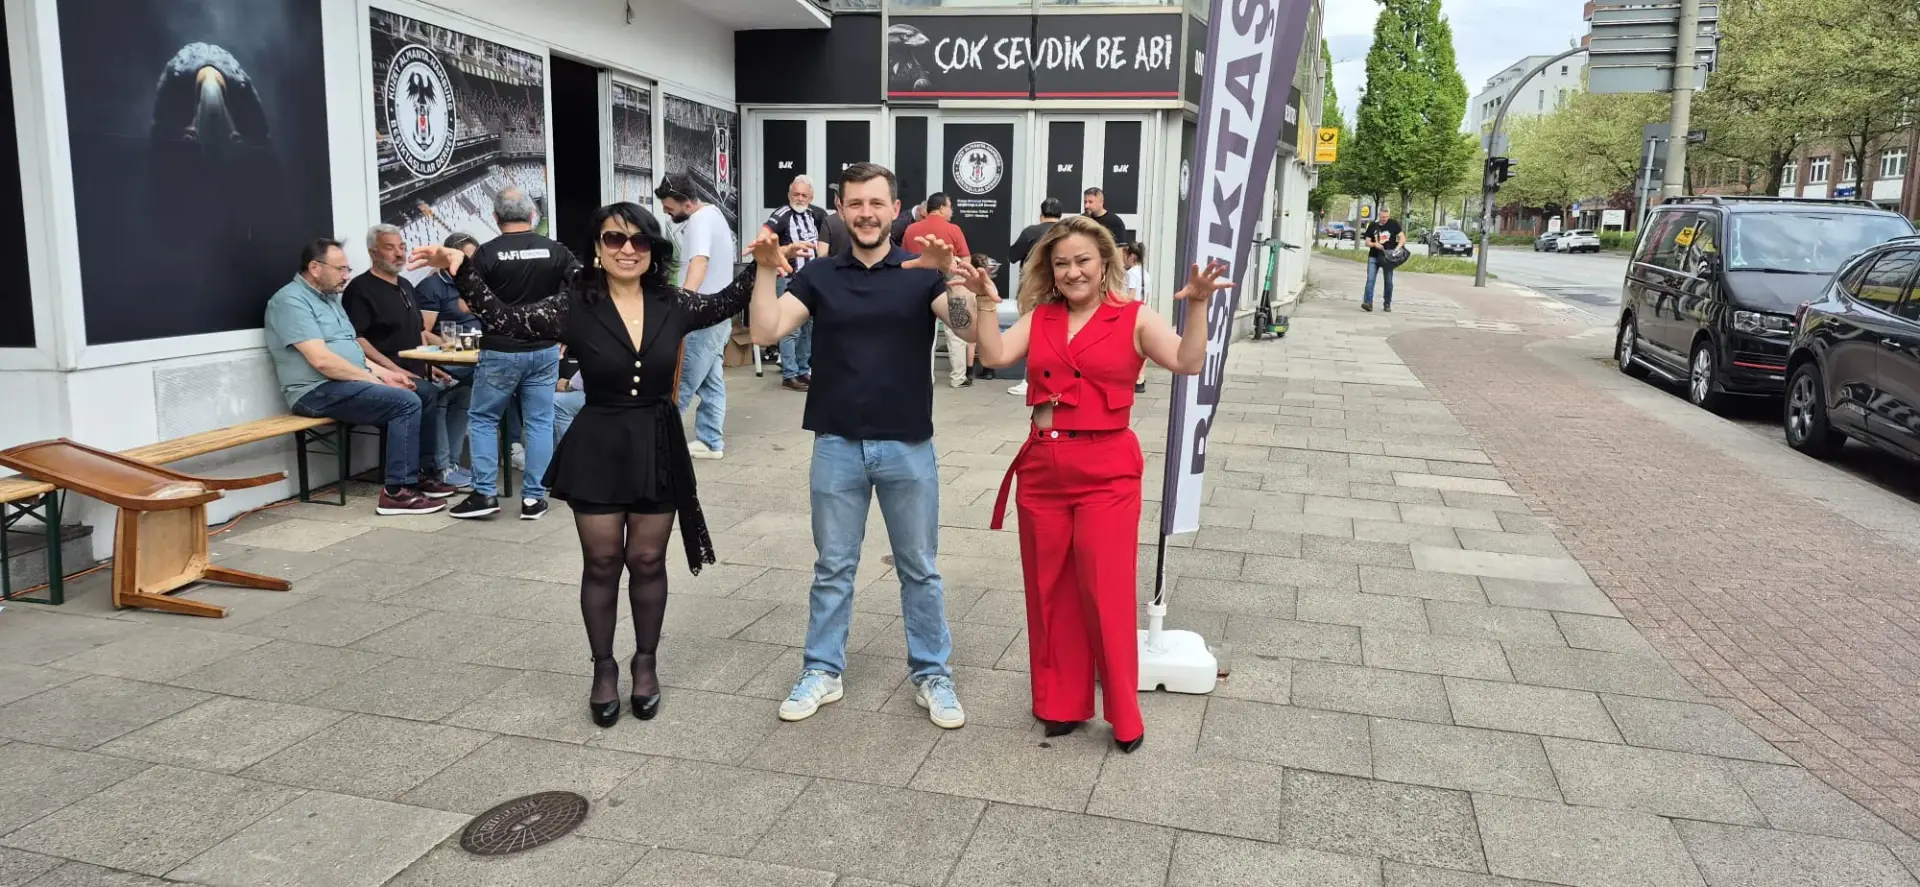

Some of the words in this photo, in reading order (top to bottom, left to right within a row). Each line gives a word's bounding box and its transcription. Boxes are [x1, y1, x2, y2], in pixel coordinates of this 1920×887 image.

[934, 34, 989, 74] ÇOK
[993, 34, 1091, 71] SEVDİK
[1095, 36, 1127, 70] BE
[1134, 34, 1173, 72] ABİ
[388, 65, 401, 100] KUZEY
[778, 161, 793, 169] BJK
[1057, 164, 1073, 172] BJK
[1113, 164, 1129, 173] BJK
